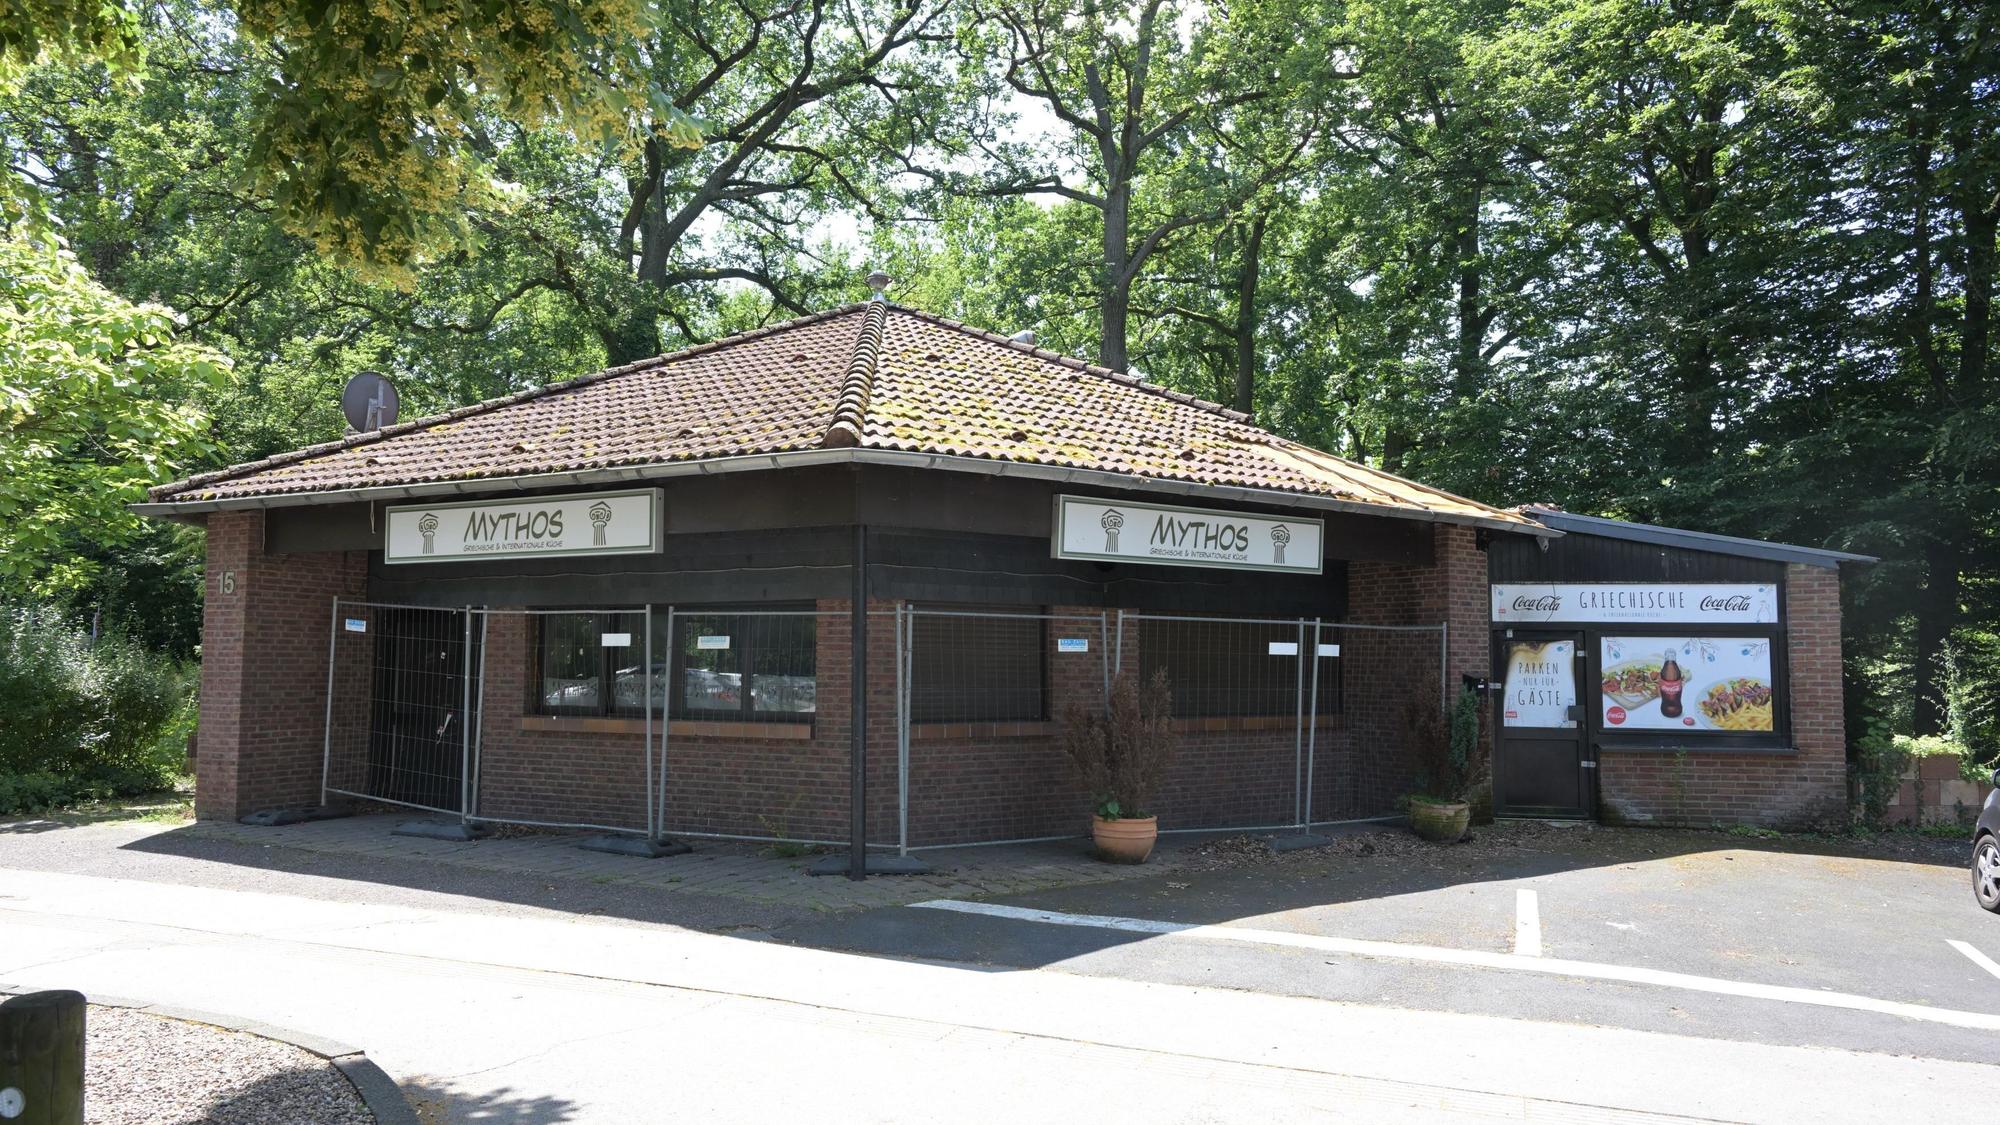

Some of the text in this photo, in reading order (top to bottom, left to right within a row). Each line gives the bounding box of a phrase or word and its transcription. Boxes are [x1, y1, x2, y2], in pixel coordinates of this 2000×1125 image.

[463, 509, 563, 543] MYTHOS
[1150, 513, 1248, 552] MYTHOS
[502, 541, 544, 550] INTERNATIONALE
[1191, 550, 1231, 560] INTERNATIONALE
[216, 571, 235, 594] 15
[1579, 591, 1686, 609] GRIECHISCHE
[1518, 662, 1559, 674] PARKEN
[1523, 678, 1537, 686] NUR
[1518, 687, 1561, 706] GÄSTE
